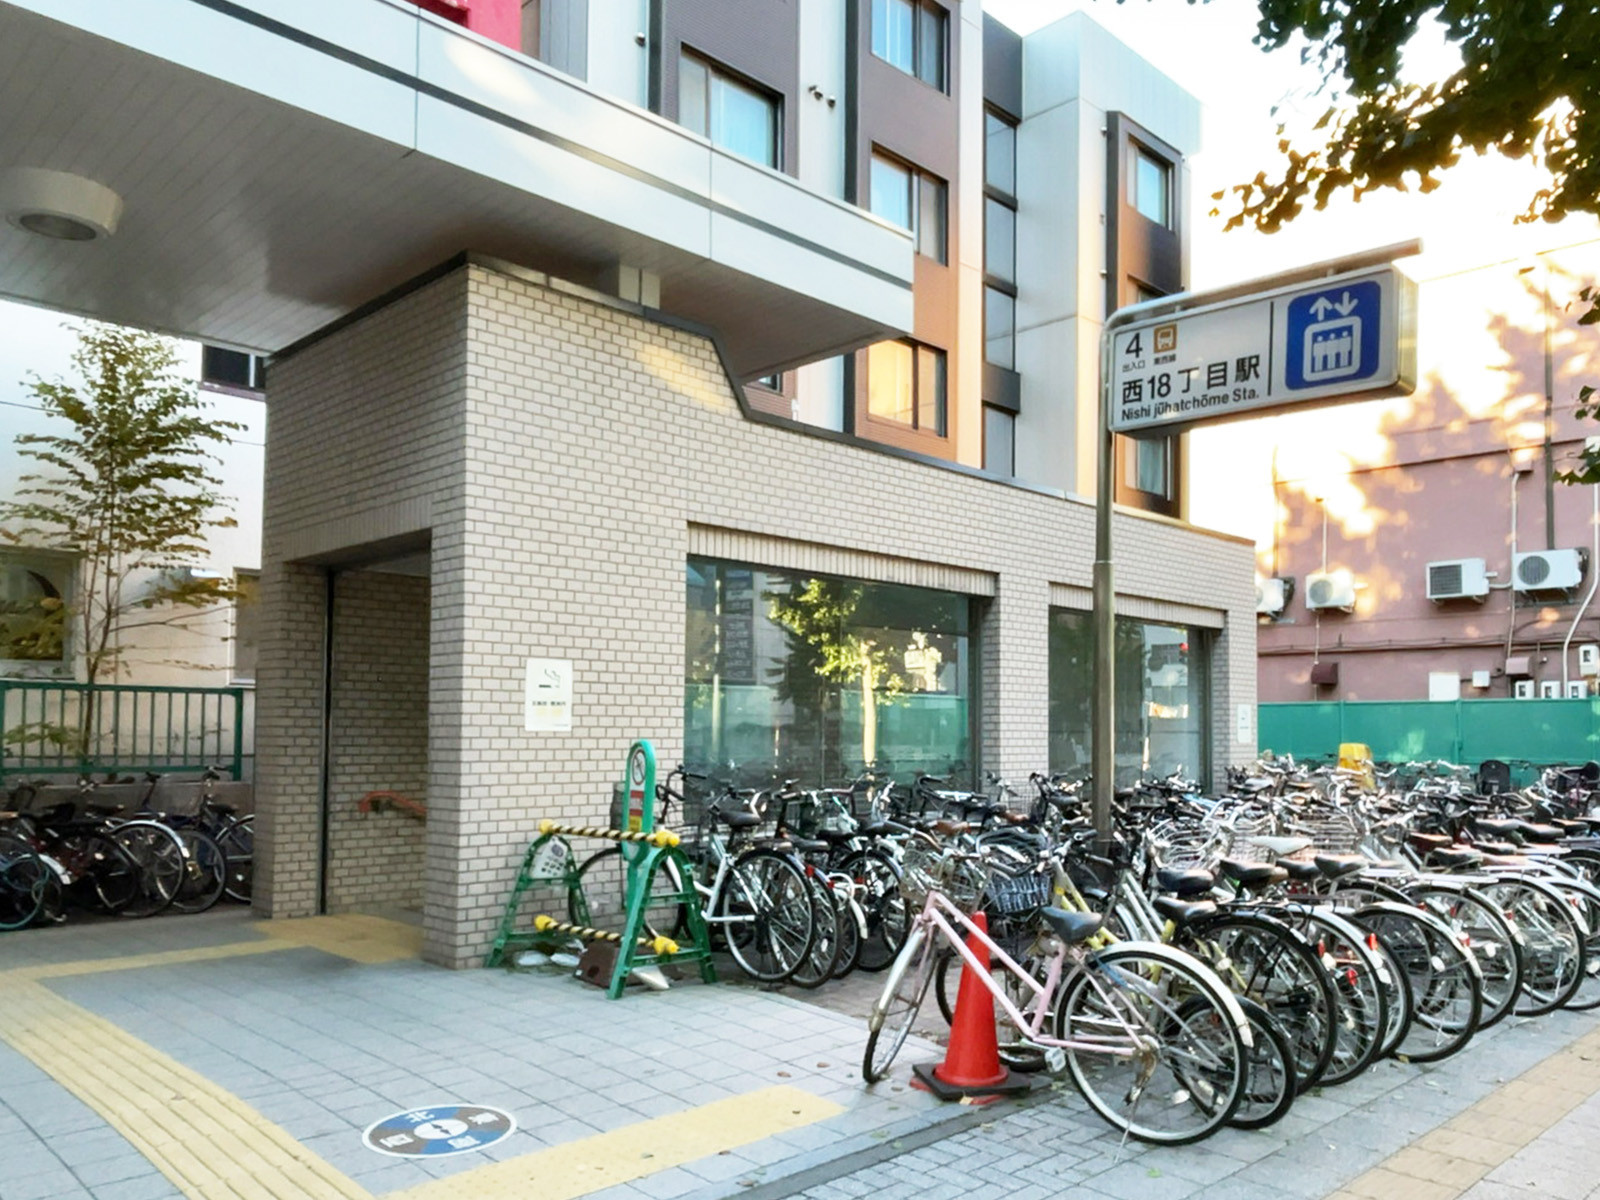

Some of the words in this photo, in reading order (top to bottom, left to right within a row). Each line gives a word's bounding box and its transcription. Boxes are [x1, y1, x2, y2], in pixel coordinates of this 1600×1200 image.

[1126, 332, 1142, 358] 4
[1122, 360, 1145, 372] 出入口
[1122, 354, 1260, 405] 西18丁目駅
[1121, 404, 1152, 421] Nishi
[1232, 387, 1260, 402] Sta.
[404, 1110, 435, 1124] 北
